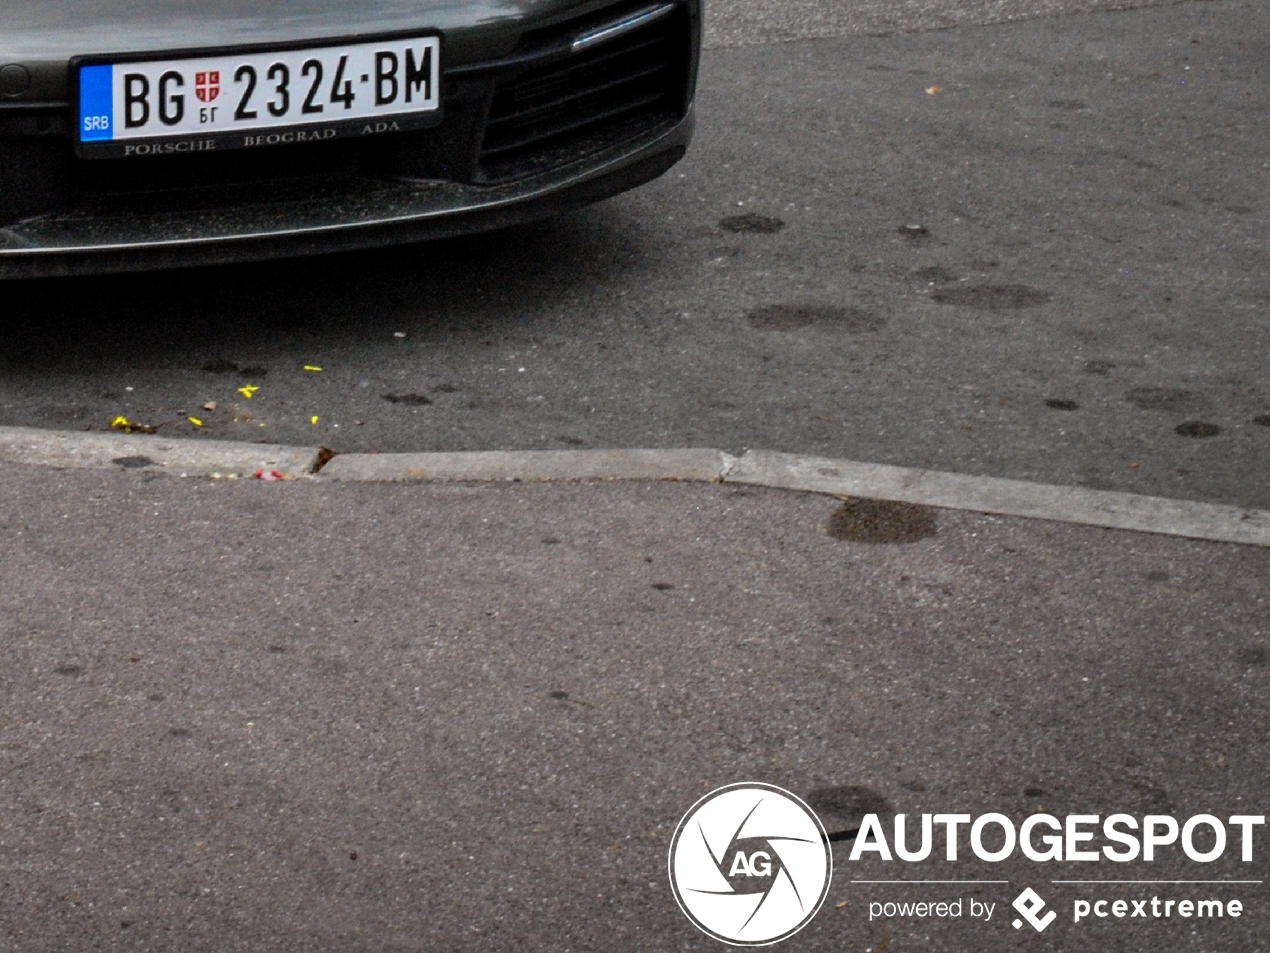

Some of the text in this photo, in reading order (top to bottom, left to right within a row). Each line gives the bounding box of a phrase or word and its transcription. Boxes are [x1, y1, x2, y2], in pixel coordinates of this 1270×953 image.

[123, 70, 186, 129] BG
[84, 115, 109, 131] SRB
[125, 121, 400, 156] PORSCHE BEOGRAD ADA
